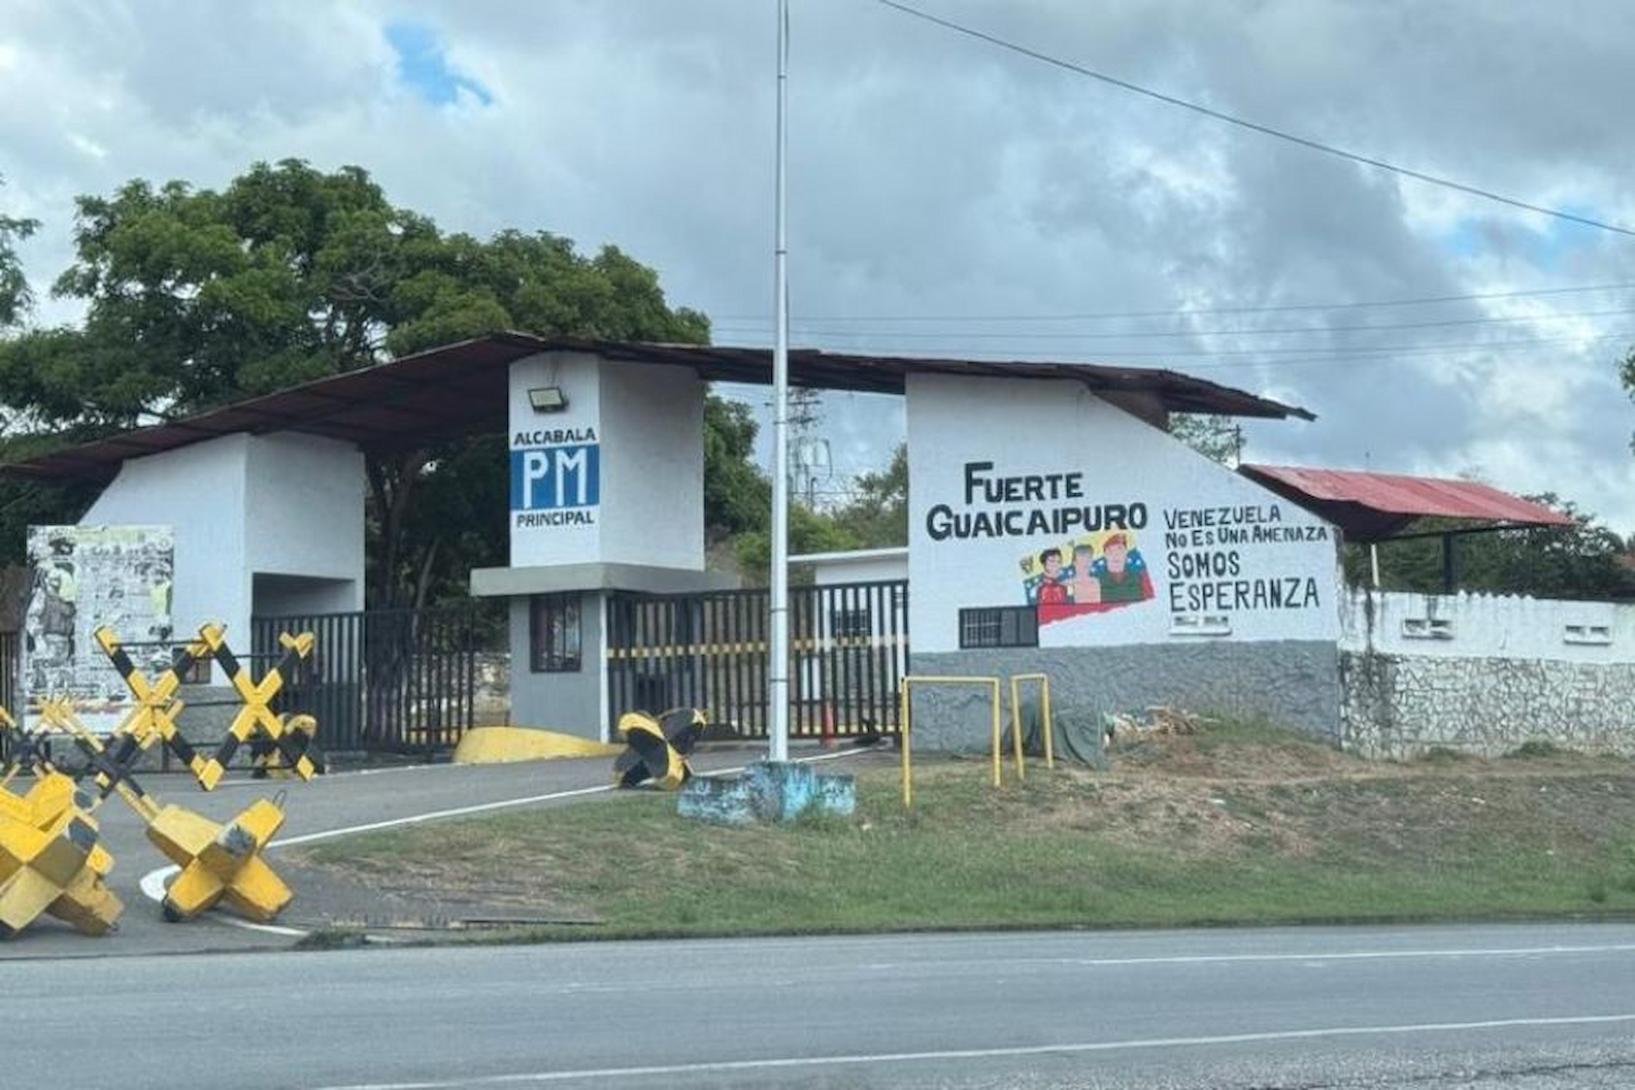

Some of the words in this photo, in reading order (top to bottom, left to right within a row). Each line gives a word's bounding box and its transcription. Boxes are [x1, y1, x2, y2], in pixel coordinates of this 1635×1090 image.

[514, 427, 596, 445] ALCABALA
[523, 447, 588, 510] PM
[965, 461, 1084, 504] FUERTE
[516, 511, 595, 528] PRINCIPAL
[926, 502, 1148, 541] GUAICAIPURO
[1164, 504, 1281, 530] VENEZUELA
[1165, 532, 1188, 549] NO
[1192, 529, 1214, 547] ES
[1217, 527, 1249, 544] UNA
[1252, 525, 1328, 543] AMENAZA
[1167, 550, 1240, 579] SOMOS
[1169, 577, 1320, 612] ESPERANZA
